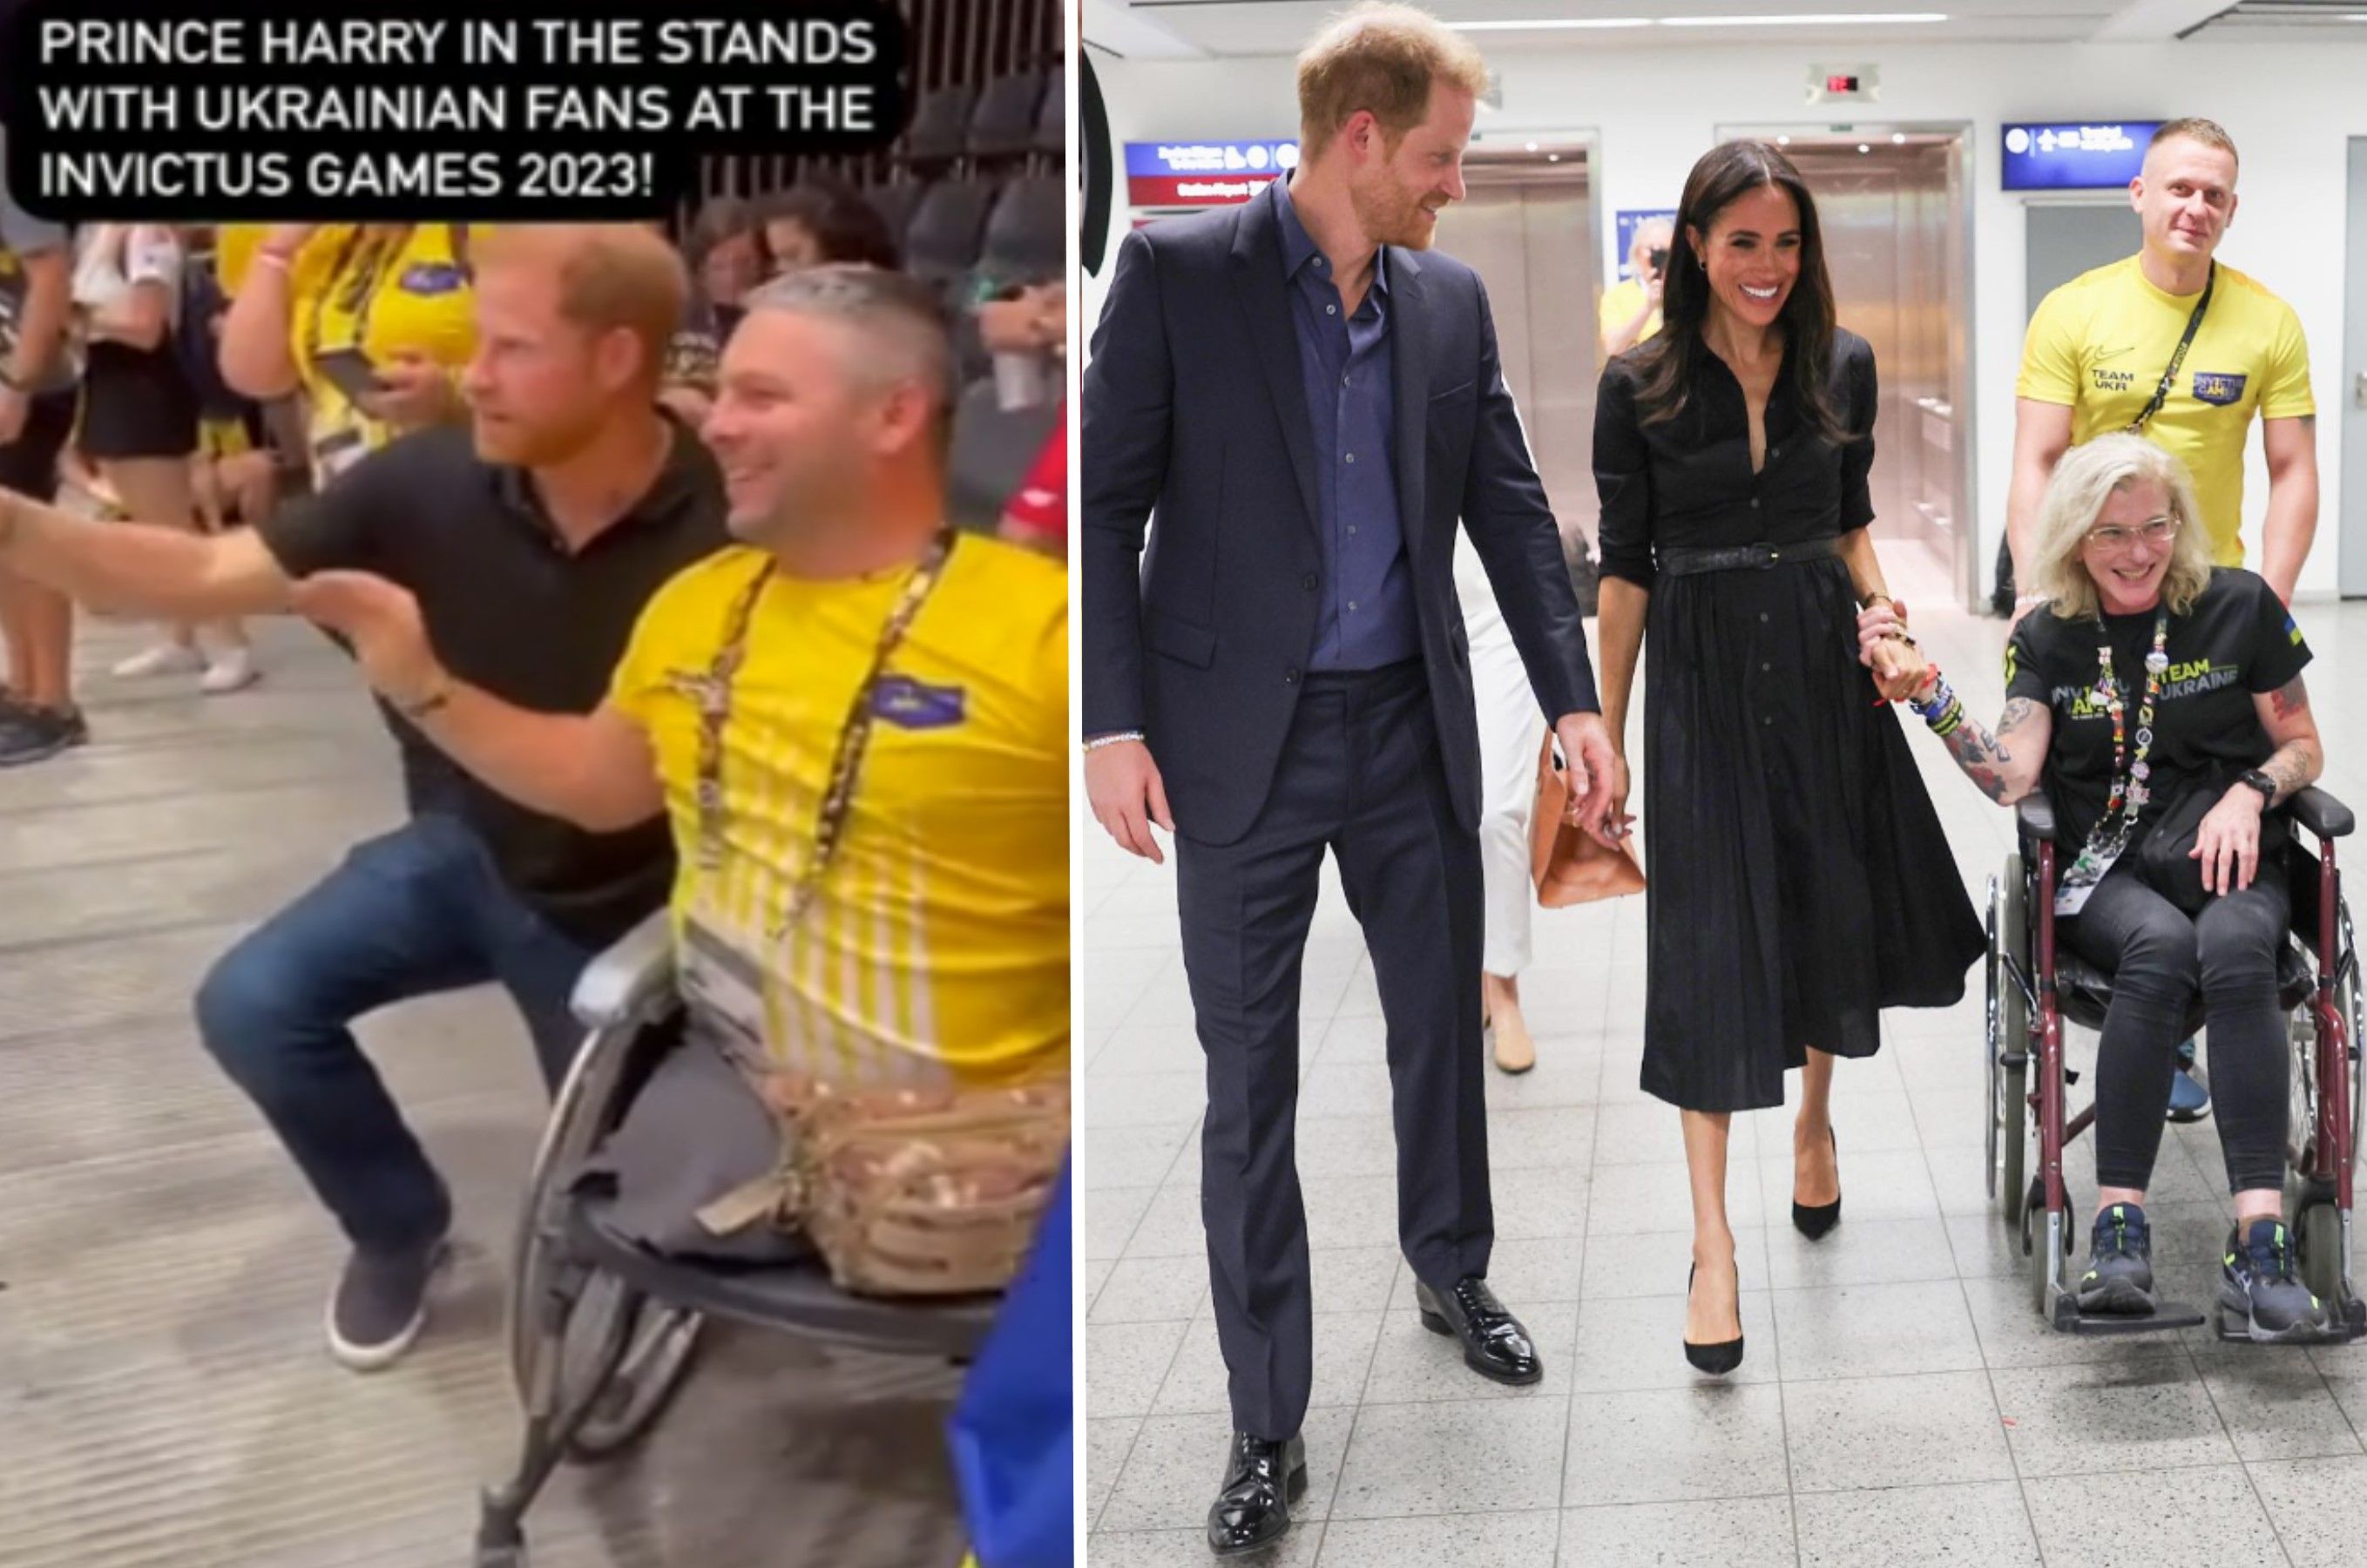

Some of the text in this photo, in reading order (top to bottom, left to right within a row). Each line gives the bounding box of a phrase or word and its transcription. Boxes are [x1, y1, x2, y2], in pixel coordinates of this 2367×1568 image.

[2092, 369, 2134, 382] TEAM
[2094, 381, 2127, 391] UKR
[2160, 659, 2209, 684] TEAM
[2159, 669, 2238, 701] UKRAINE
